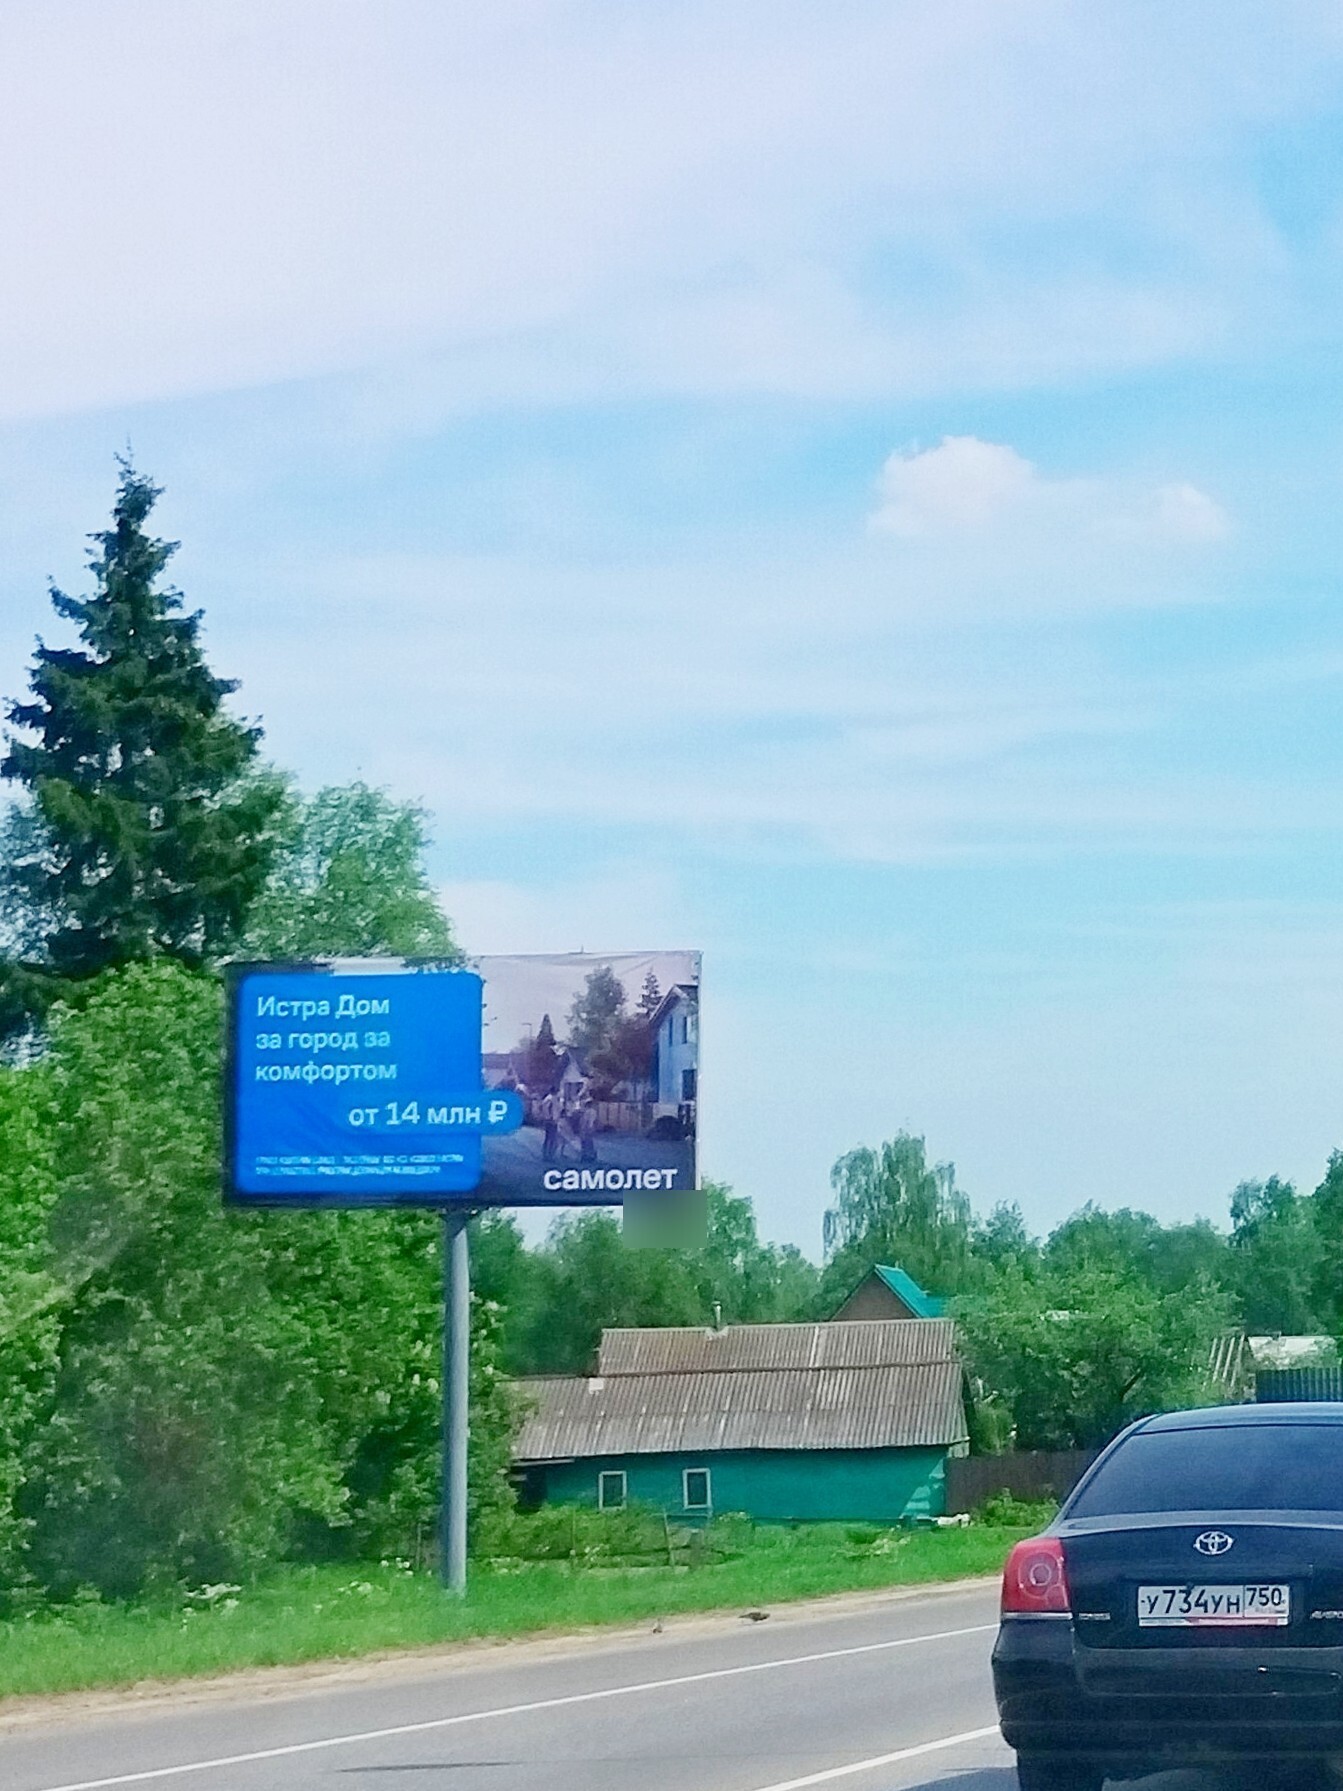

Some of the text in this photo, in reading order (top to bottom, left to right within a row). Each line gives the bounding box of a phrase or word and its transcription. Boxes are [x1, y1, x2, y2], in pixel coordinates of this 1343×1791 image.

[257, 994, 390, 1021] Истра Дом
[256, 1030, 391, 1054] за город за
[255, 1060, 398, 1086] комфортом
[348, 1108, 379, 1127] от
[386, 1101, 420, 1126] 14
[427, 1106, 481, 1125] млн
[543, 1168, 678, 1190] самолет
